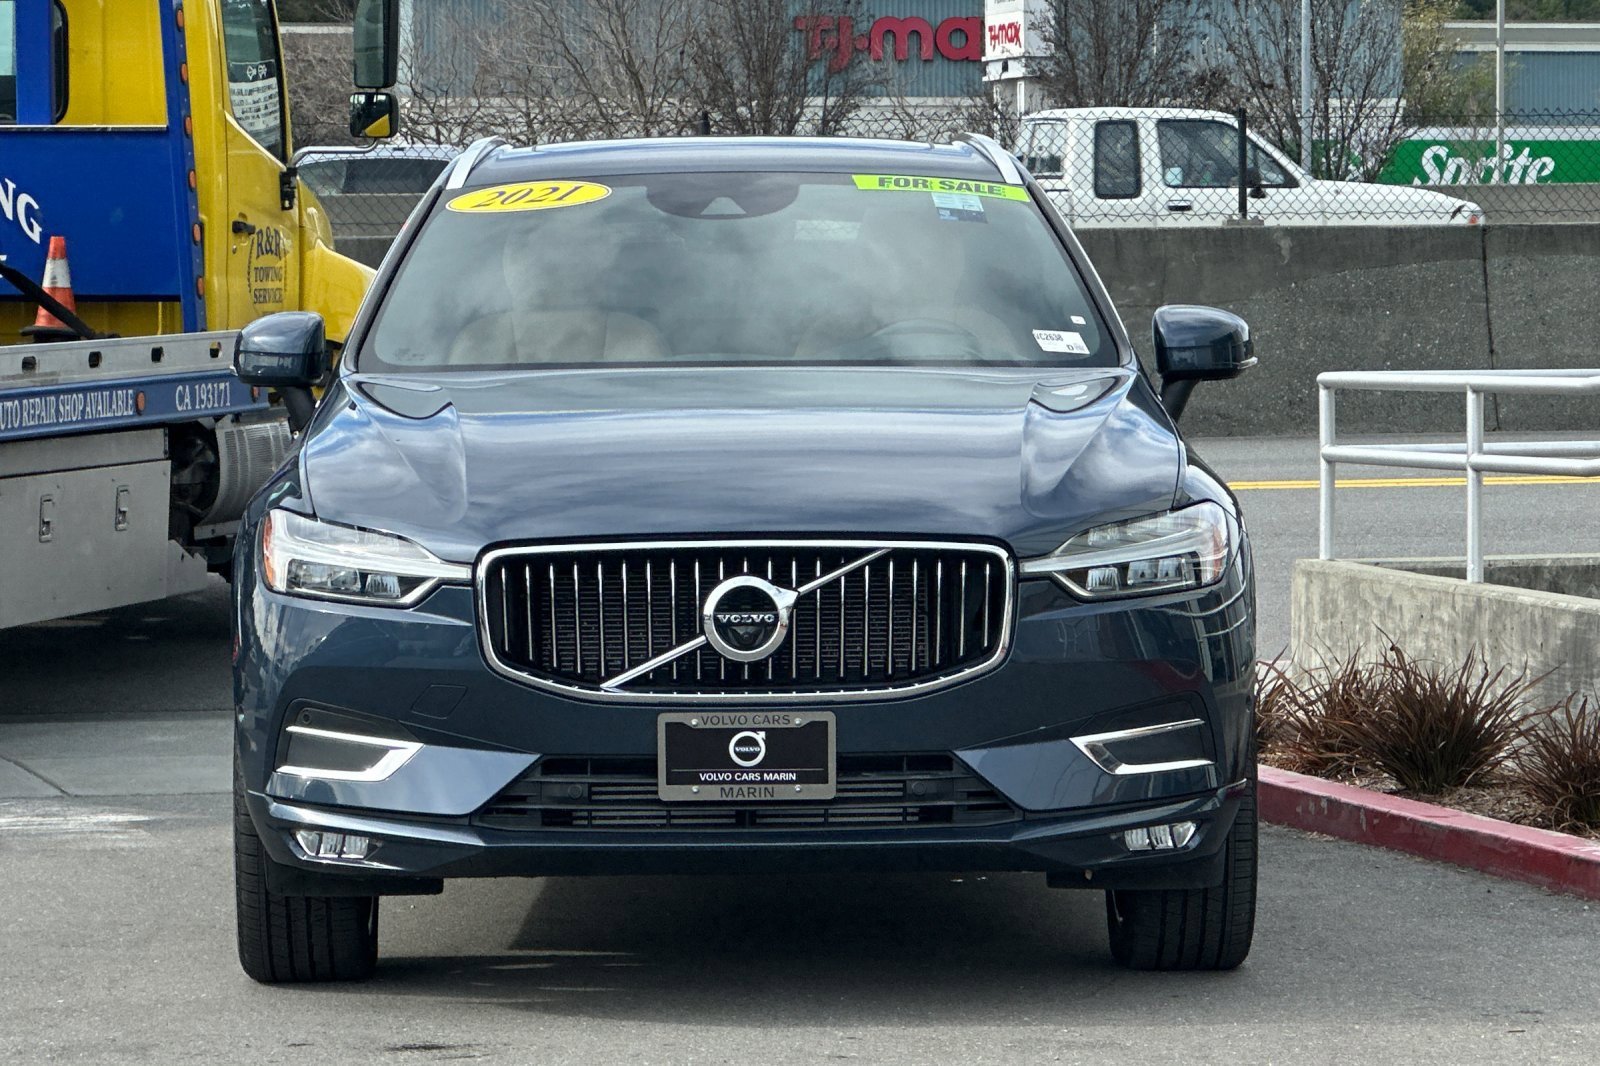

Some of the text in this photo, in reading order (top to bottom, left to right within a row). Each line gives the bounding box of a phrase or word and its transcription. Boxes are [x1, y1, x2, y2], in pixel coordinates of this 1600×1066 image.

[1413, 144, 1556, 185] Sprite
[877, 176, 1003, 196] FOR SALE
[470, 185, 585, 209] 2021
[255, 226, 282, 261] R&R
[253, 266, 283, 283] TOWING
[253, 287, 283, 304] SERVICE
[175, 382, 231, 412] CA 193171
[22, 395, 57, 427] REPAIR
[58, 393, 84, 423] SHOP
[85, 389, 134, 420] AVAILABLE
[716, 613, 776, 624] VOLVO
[701, 714, 791, 726] VOLVO CARS
[699, 772, 797, 781] VOLVO CARS MARIN
[720, 786, 775, 799] MARIN
